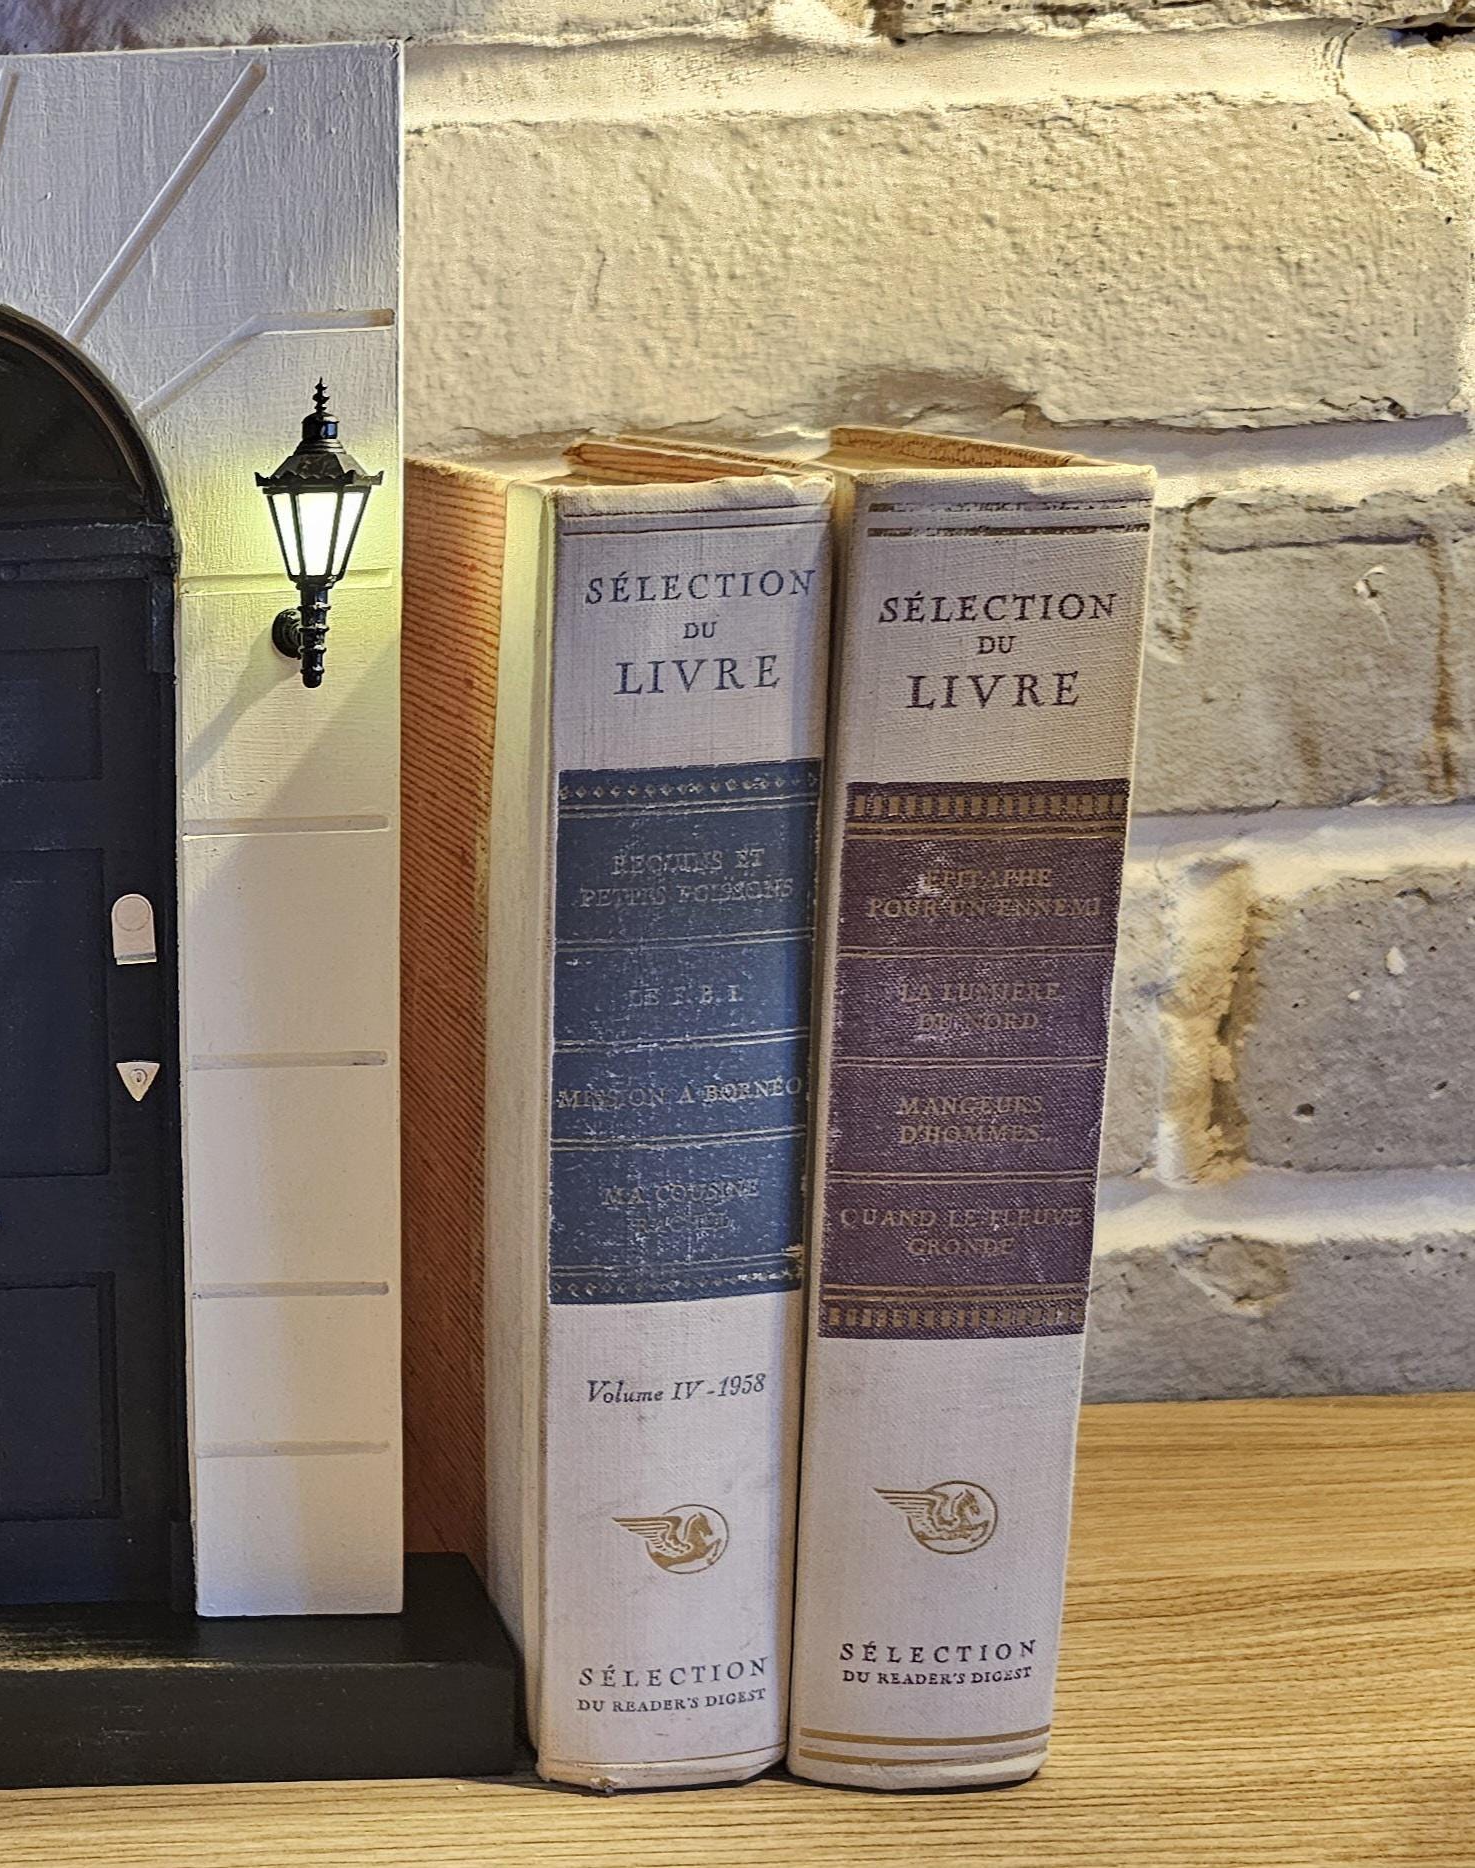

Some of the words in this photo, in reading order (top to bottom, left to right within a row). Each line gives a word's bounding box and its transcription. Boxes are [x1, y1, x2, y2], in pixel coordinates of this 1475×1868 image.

[585, 570, 816, 604] SÉLECTION
[878, 590, 1118, 622] SÉLECTION
[683, 621, 717, 639] DU
[977, 635, 1017, 655] DU
[614, 655, 781, 695] LIVRE
[906, 671, 1080, 709] LIVRE
[840, 1208, 938, 1229] QUAND
[587, 1379, 664, 1404] Volume
[839, 1640, 1037, 1664] SÉLECTION
[579, 1656, 768, 1688] SÉLECTION
[843, 1670, 870, 1684] DU
[877, 1671, 966, 1685] READER'S
[971, 1666, 1033, 1684] DIGEST
[577, 1698, 605, 1712] DU
[612, 1696, 699, 1713] READER'S
[705, 1688, 767, 1707] DIGEST
